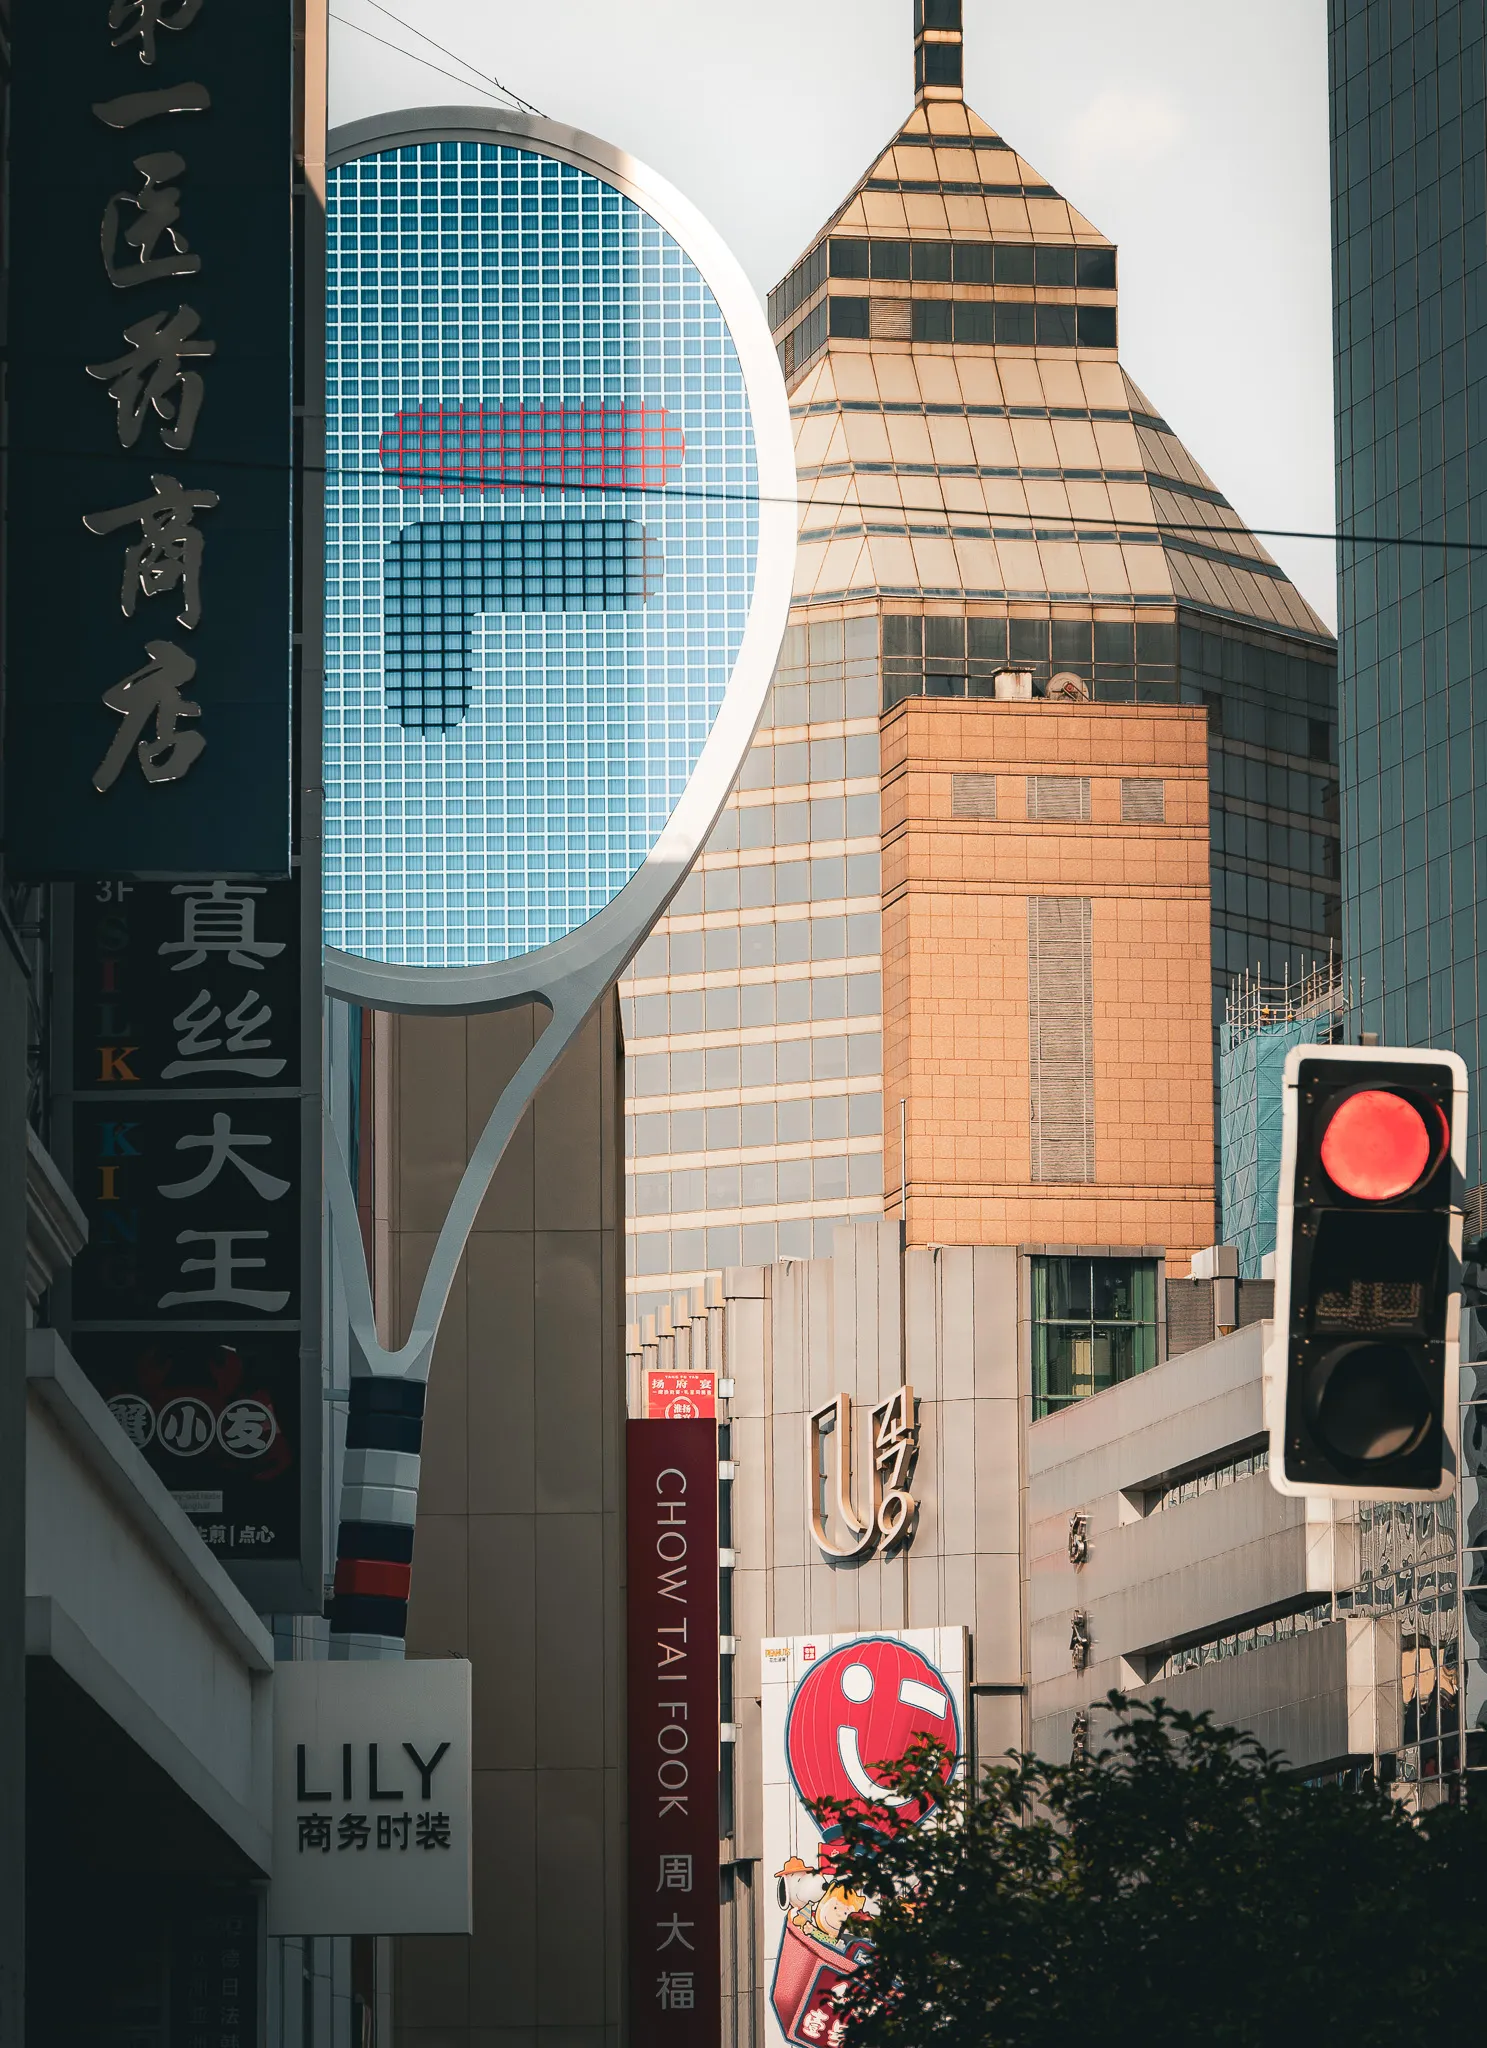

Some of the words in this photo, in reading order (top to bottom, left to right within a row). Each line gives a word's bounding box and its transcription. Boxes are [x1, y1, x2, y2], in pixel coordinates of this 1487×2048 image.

[157, 880, 291, 1312] 真丝大王
[656, 1469, 687, 1603] CHOW
[657, 1617, 687, 1680] TAI
[297, 1742, 451, 1801] LILY
[658, 1701, 688, 1818] FOOK
[296, 1811, 452, 1852] 商务时装
[656, 1855, 695, 2010] 周大福
